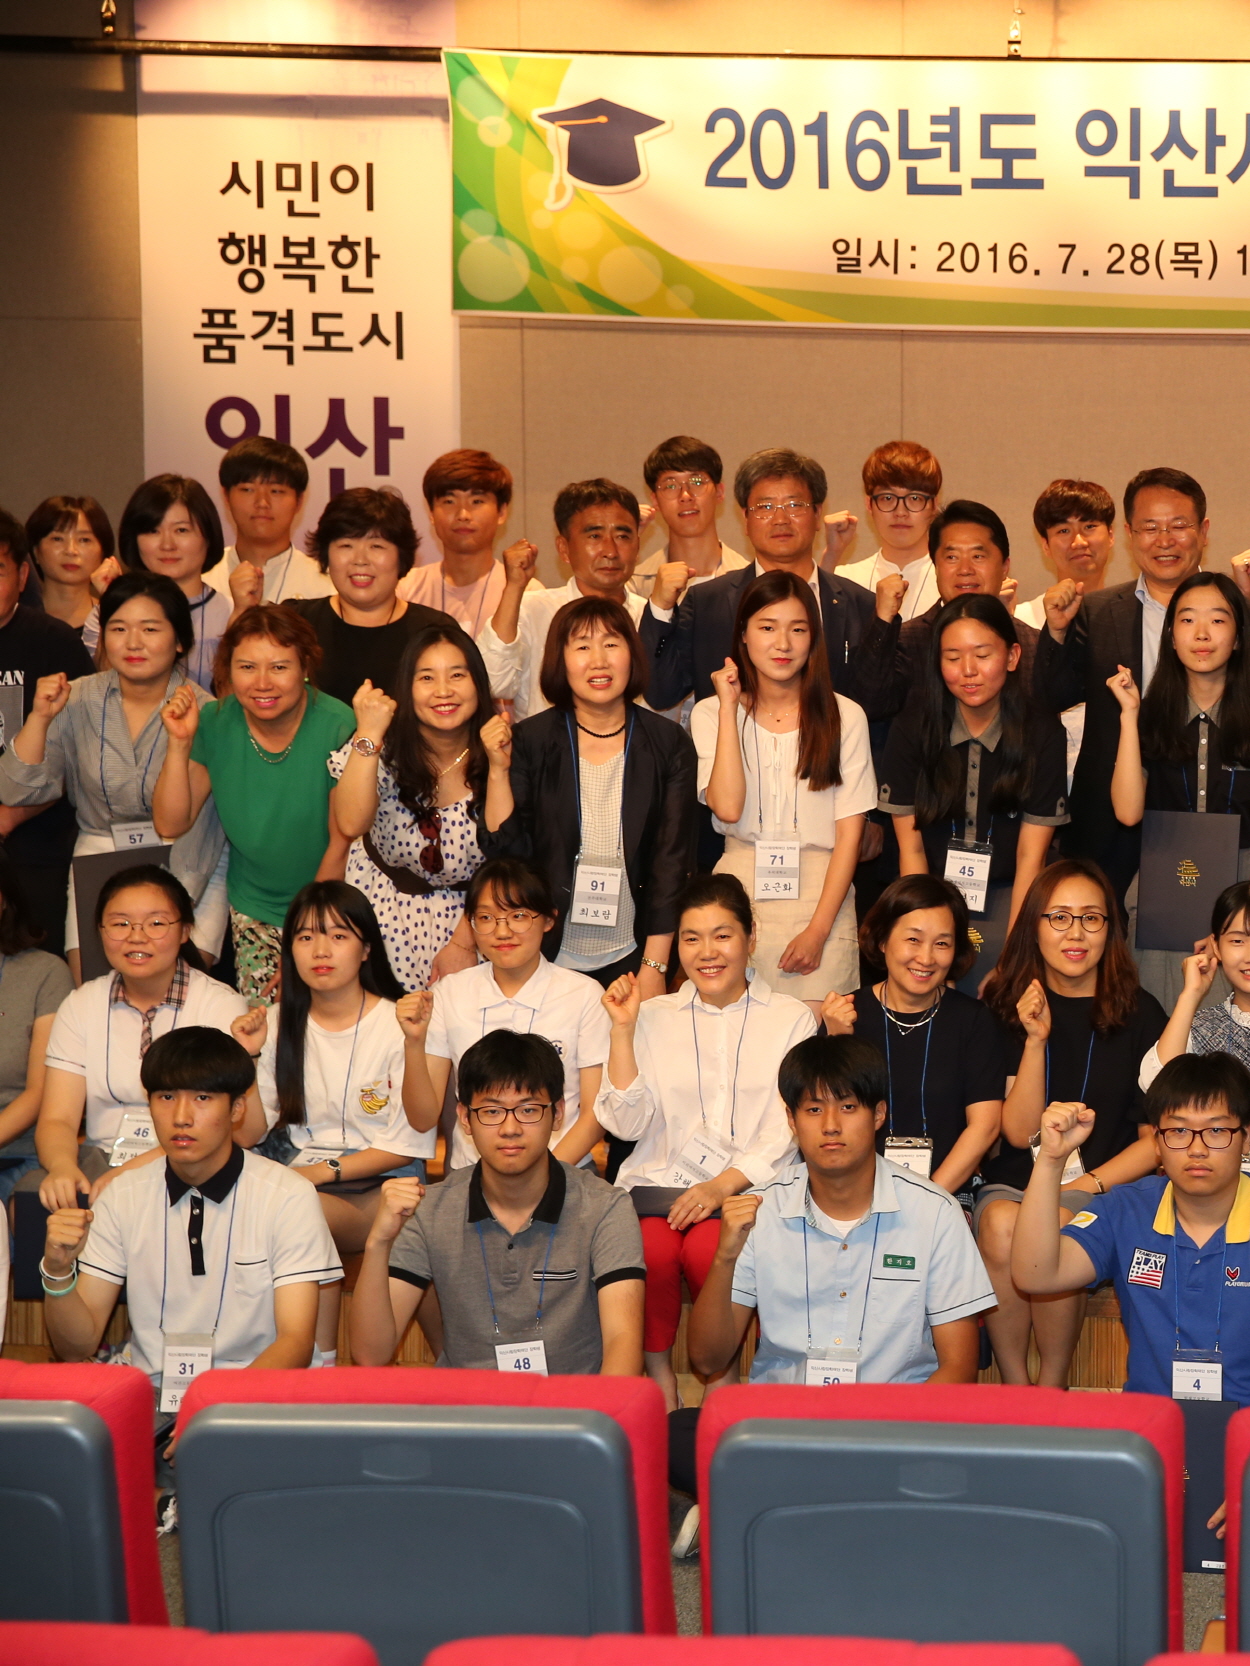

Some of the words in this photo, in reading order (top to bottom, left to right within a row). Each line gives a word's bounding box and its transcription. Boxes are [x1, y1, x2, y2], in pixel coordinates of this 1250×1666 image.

[704, 106, 1045, 197] 2016년도
[219, 160, 376, 218] 시민이
[217, 231, 381, 295] 행복한
[831, 237, 918, 275] 일시:
[935, 241, 1042, 277] 2016.
[1057, 243, 1091, 277] 7.
[1105, 239, 1220, 280] 28(목)
[193, 308, 405, 366] 품격도시
[0, 670, 24, 685] AN
[129, 833, 144, 844] 57
[769, 854, 784, 866] 71
[958, 865, 975, 877] 45
[590, 880, 605, 892] 91
[133, 1126, 150, 1138] 46
[698, 1154, 707, 1165] 1
[1134, 1256, 1165, 1271] PLAY
[178, 1362, 195, 1375] 31
[513, 1357, 531, 1371] 48
[822, 1376, 841, 1387] 50
[1192, 1378, 1202, 1391] 4
